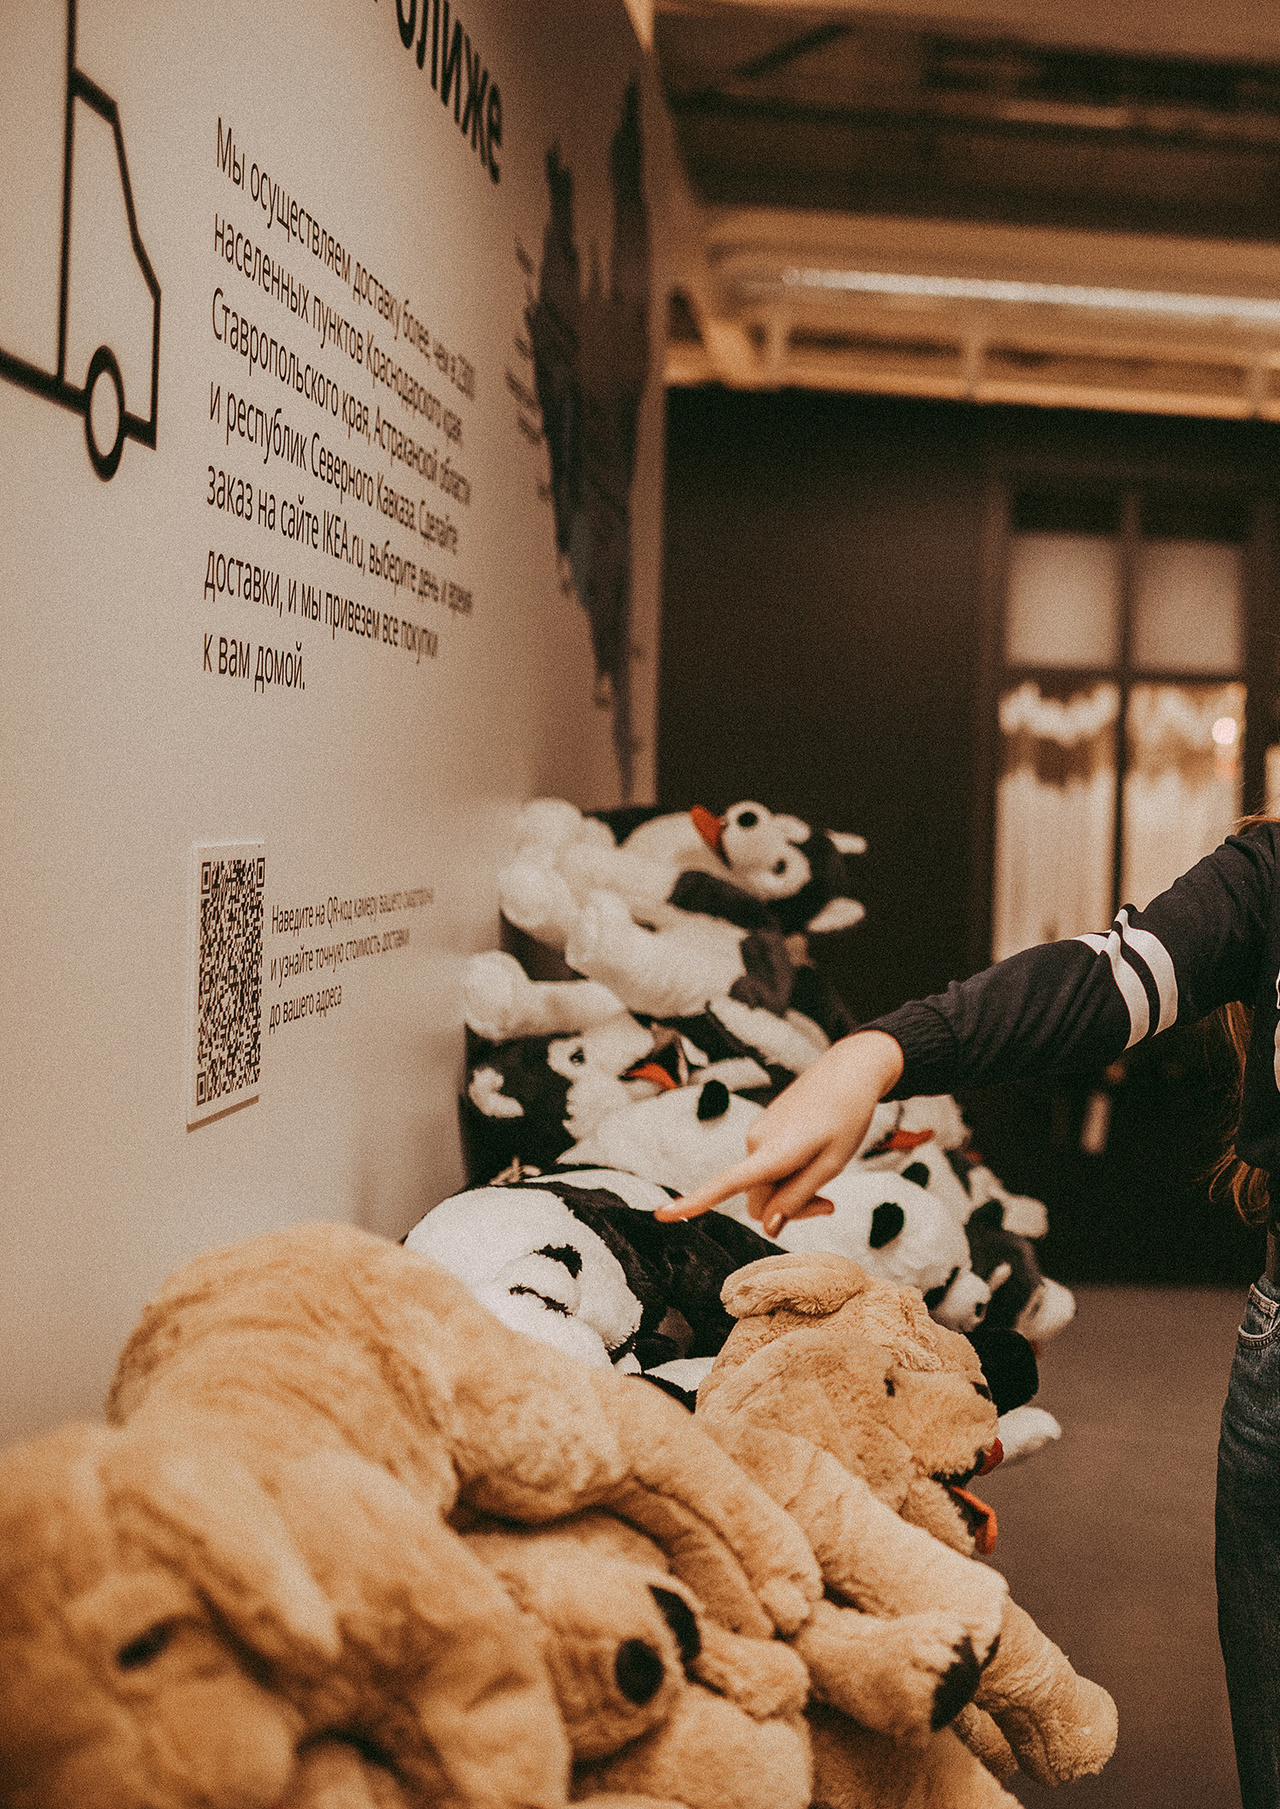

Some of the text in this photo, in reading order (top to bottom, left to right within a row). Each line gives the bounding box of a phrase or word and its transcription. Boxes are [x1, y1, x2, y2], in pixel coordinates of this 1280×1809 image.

[217, 117, 245, 190] Мы
[251, 163, 351, 285] осуществляем
[353, 262, 399, 341] доставку
[214, 213, 309, 323] населенных
[313, 295, 363, 364] пунктов
[212, 287, 339, 416] Ставропольского
[342, 390, 370, 446] края,
[210, 381, 221, 423] и
[226, 391, 307, 471] республик
[311, 432, 374, 506] Северного
[207, 466, 253, 521] заказ
[258, 489, 276, 531] на
[281, 494, 319, 550] сайте
[323, 510, 365, 576] IKEA.ru,
[369, 540, 417, 595] выберите
[204, 550, 283, 618] доставки,
[288, 578, 297, 615] и
[301, 583, 321, 622] мы
[325, 592, 380, 641] привезем
[382, 613, 398, 647] все
[218, 636, 250, 679] вам
[254, 641, 306, 694] домой.
[270, 958, 277, 981] и
[278, 944, 313, 988] узнайте
[315, 943, 344, 973] точную
[271, 904, 314, 937] Наведите
[315, 904, 326, 927] на
[327, 896, 353, 928] QR-код
[268, 985, 342, 1035] до вашего адреса
